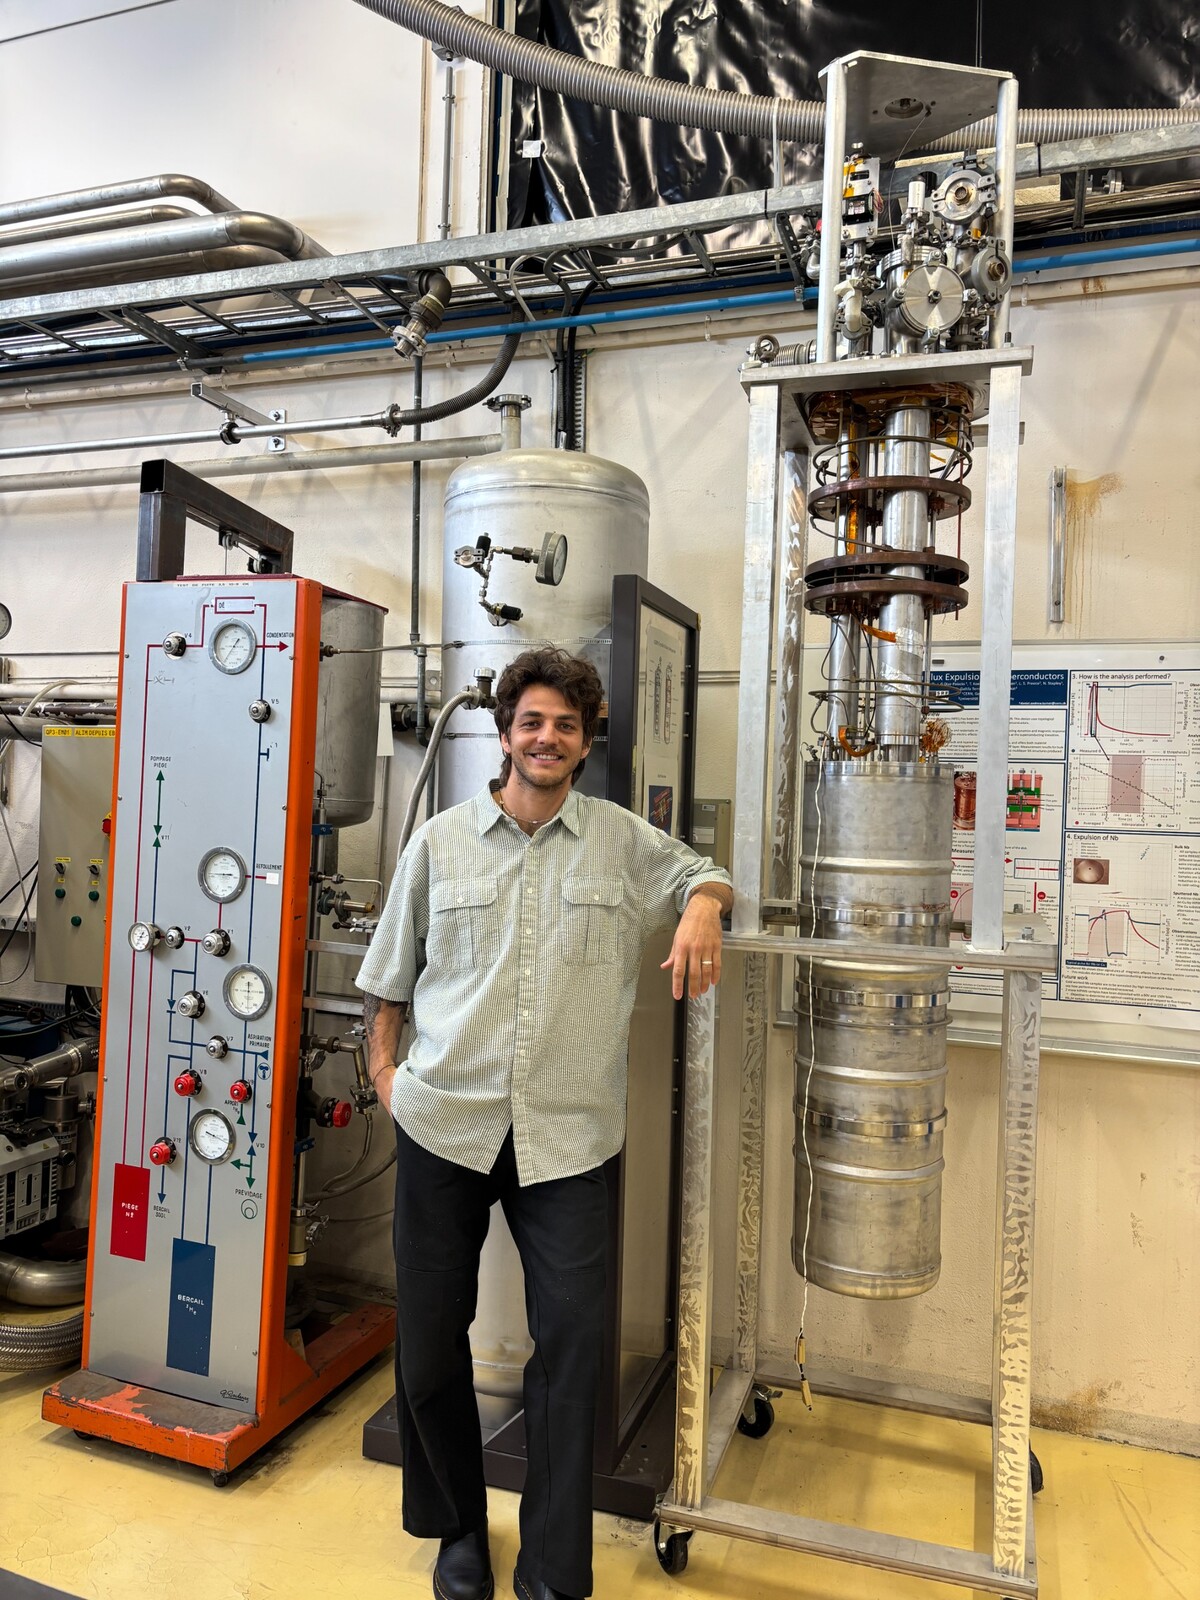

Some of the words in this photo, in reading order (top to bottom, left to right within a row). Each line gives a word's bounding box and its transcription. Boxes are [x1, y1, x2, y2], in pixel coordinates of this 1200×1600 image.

[945, 673, 980, 682] Expulsio
[235, 1188, 262, 1199] PREVIDAGE
[122, 1202, 138, 1210] PIEGE
[178, 1294, 204, 1305] BERCAIL
